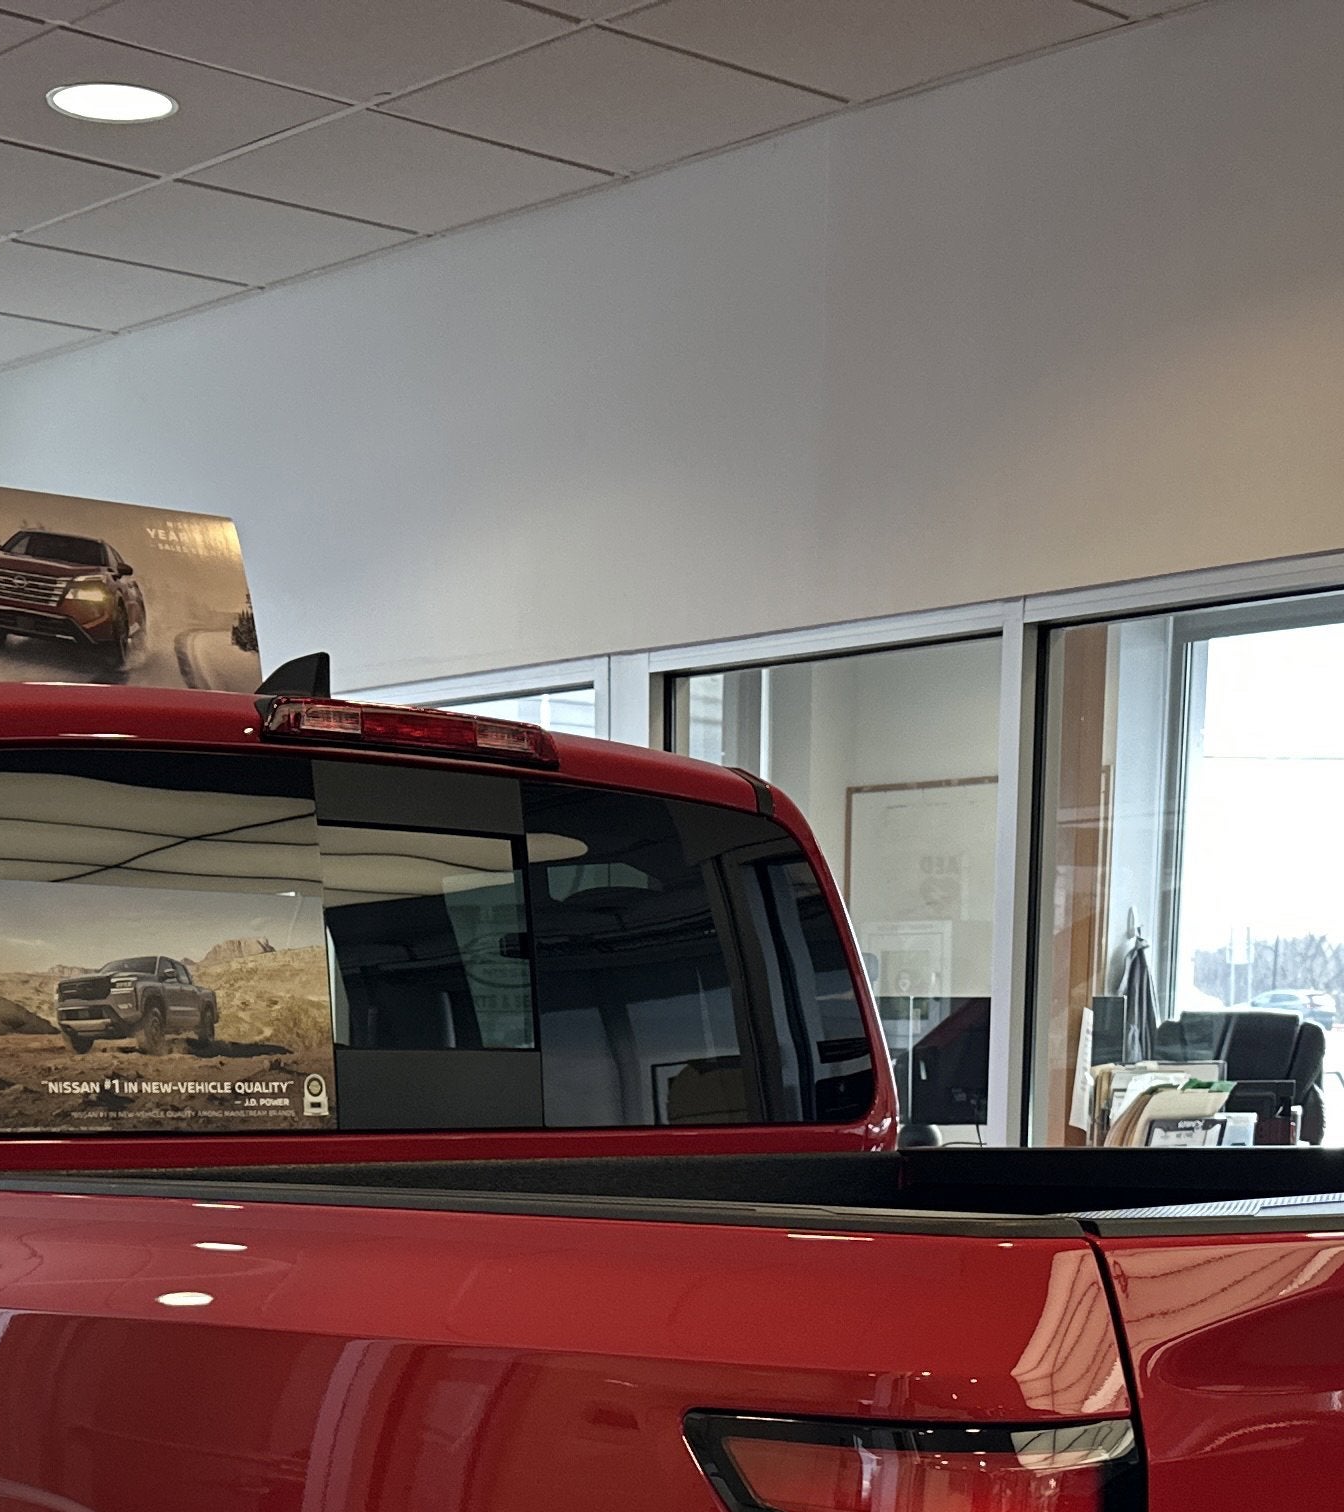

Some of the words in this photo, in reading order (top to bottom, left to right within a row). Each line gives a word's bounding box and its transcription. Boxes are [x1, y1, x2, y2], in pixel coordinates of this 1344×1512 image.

[104, 1079, 119, 1093] #1
[124, 1081, 138, 1093] IN
[141, 1081, 232, 1094] NEW-VEHICLE
[259, 1098, 290, 1107] POWER
